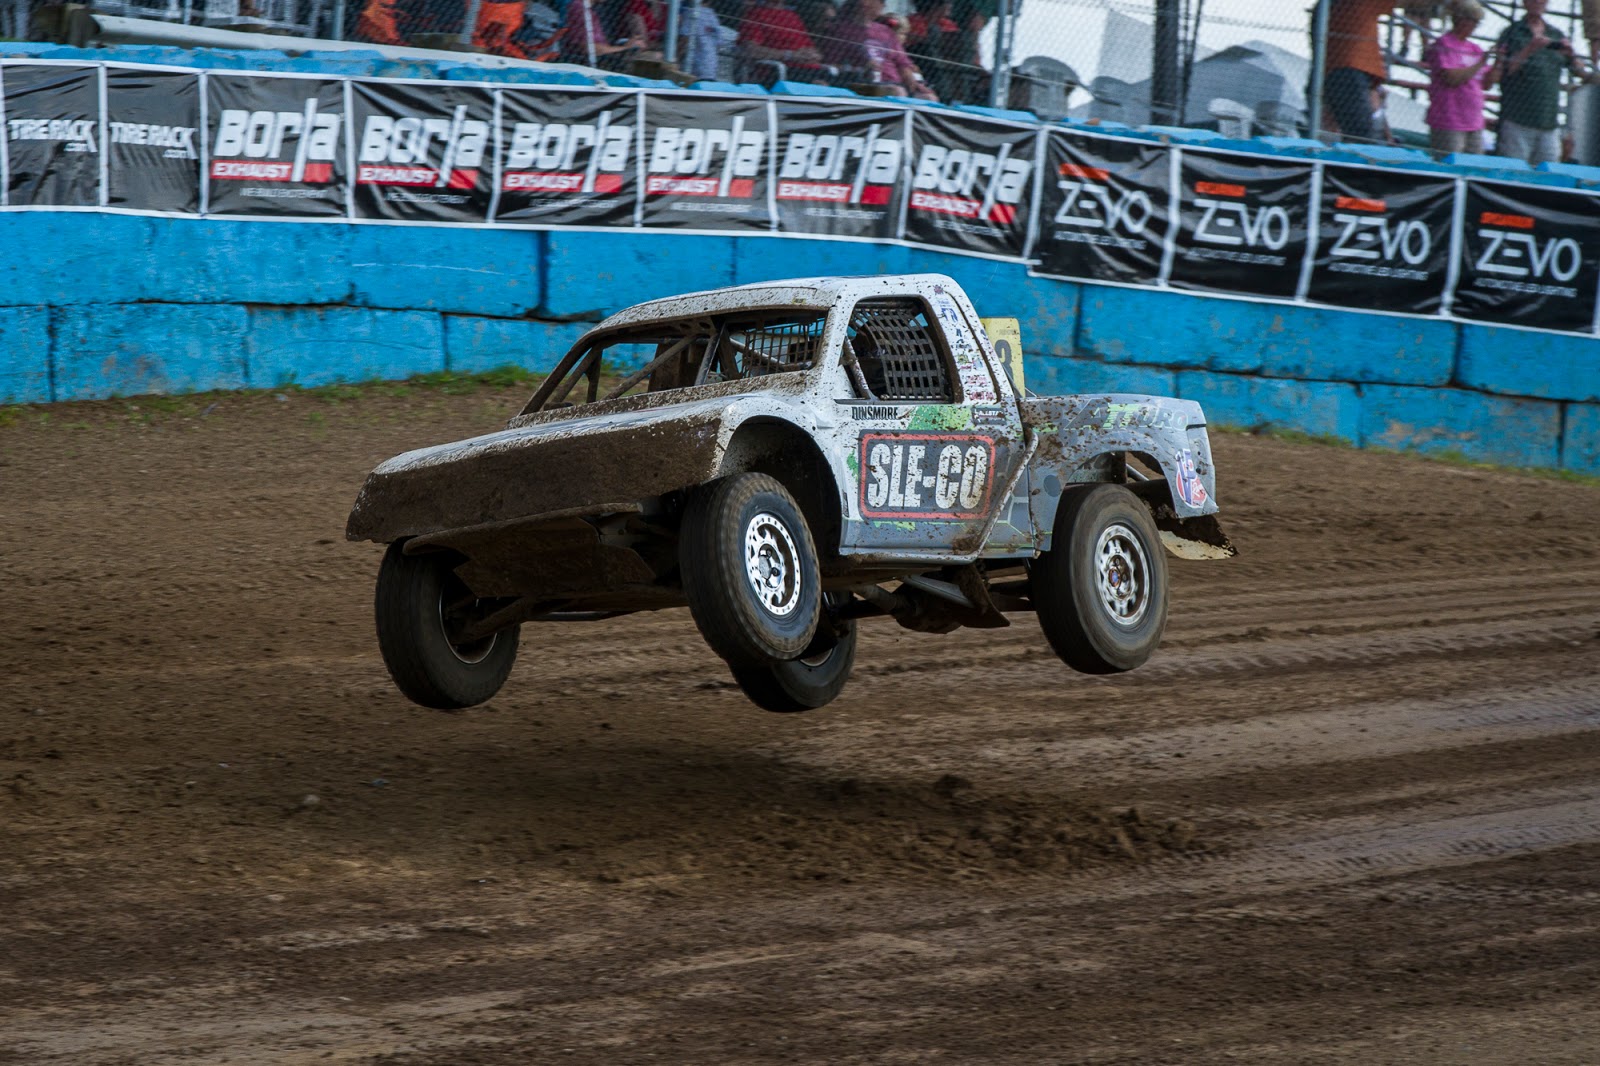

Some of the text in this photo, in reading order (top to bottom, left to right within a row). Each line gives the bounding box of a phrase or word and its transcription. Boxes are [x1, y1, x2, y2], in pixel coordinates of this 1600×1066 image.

[213, 162, 292, 178] EXHAUST
[360, 167, 439, 184] EXHAUST
[505, 174, 584, 190] EXHAUST
[647, 178, 719, 194] EXHAUST
[778, 182, 851, 200] EXHAUST
[911, 192, 981, 217] EXHAUST
[1055, 180, 1153, 234] ZEVO
[1193, 198, 1290, 250] ZEVO
[1330, 213, 1431, 265] ZEVO
[1476, 229, 1582, 282] ZEVO
[851, 406, 899, 420] DINSMORE
[867, 443, 988, 510] SLE-CO
